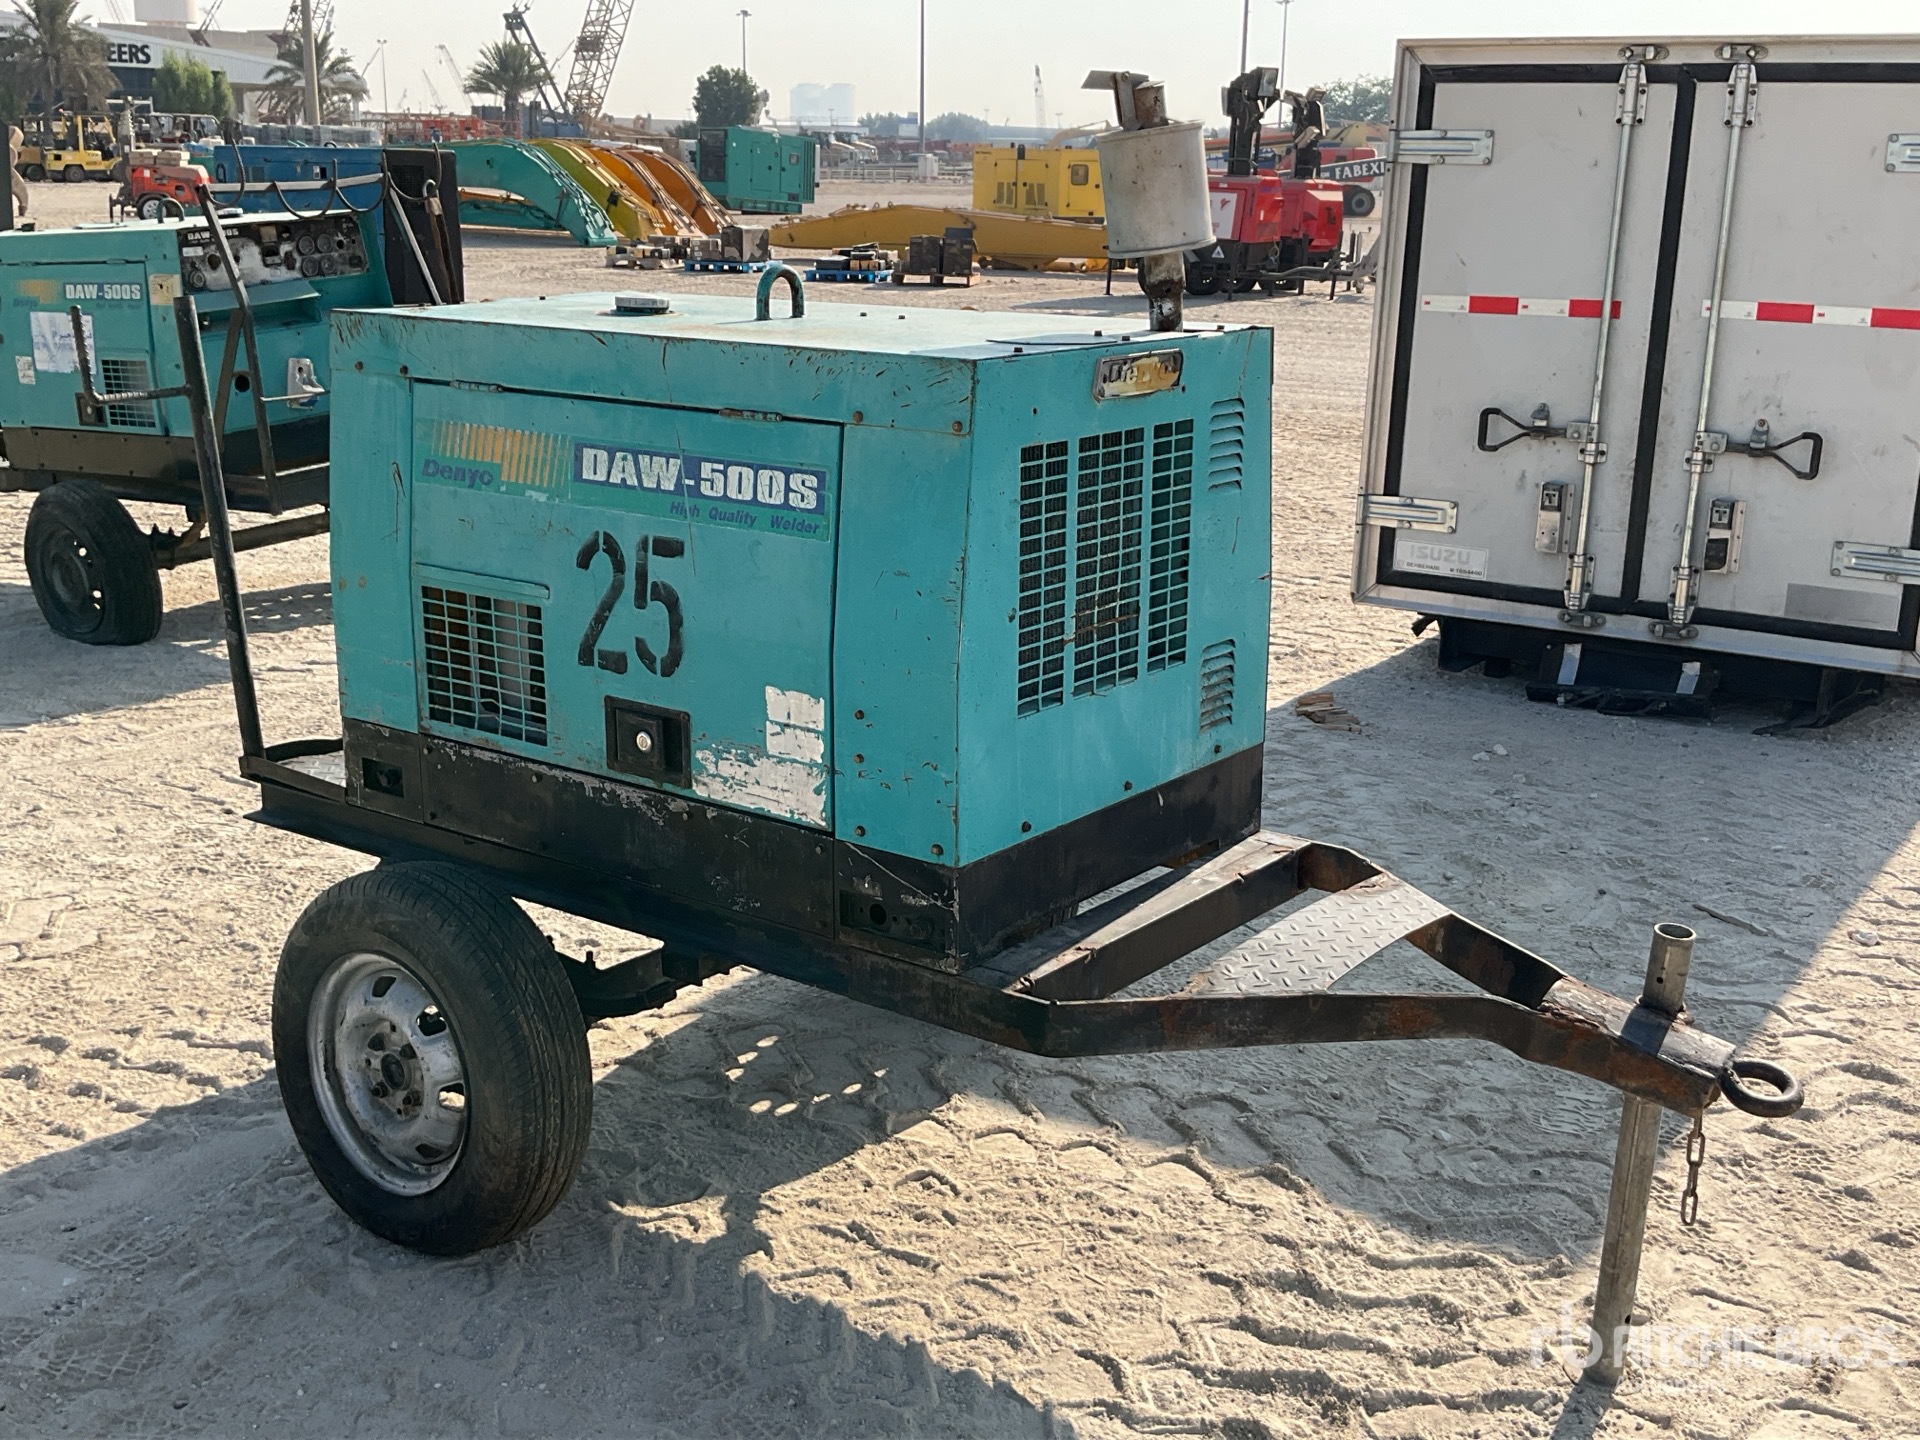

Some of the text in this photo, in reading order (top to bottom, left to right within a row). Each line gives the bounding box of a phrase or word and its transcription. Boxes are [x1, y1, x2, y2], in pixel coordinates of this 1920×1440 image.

[65, 284, 141, 300] DAW-500S
[421, 458, 494, 489] Denyo
[582, 447, 818, 510] DAW-500S
[670, 501, 820, 535] High Quality Welder
[1410, 545, 1471, 566] ISUZU
[575, 530, 684, 678] 25
